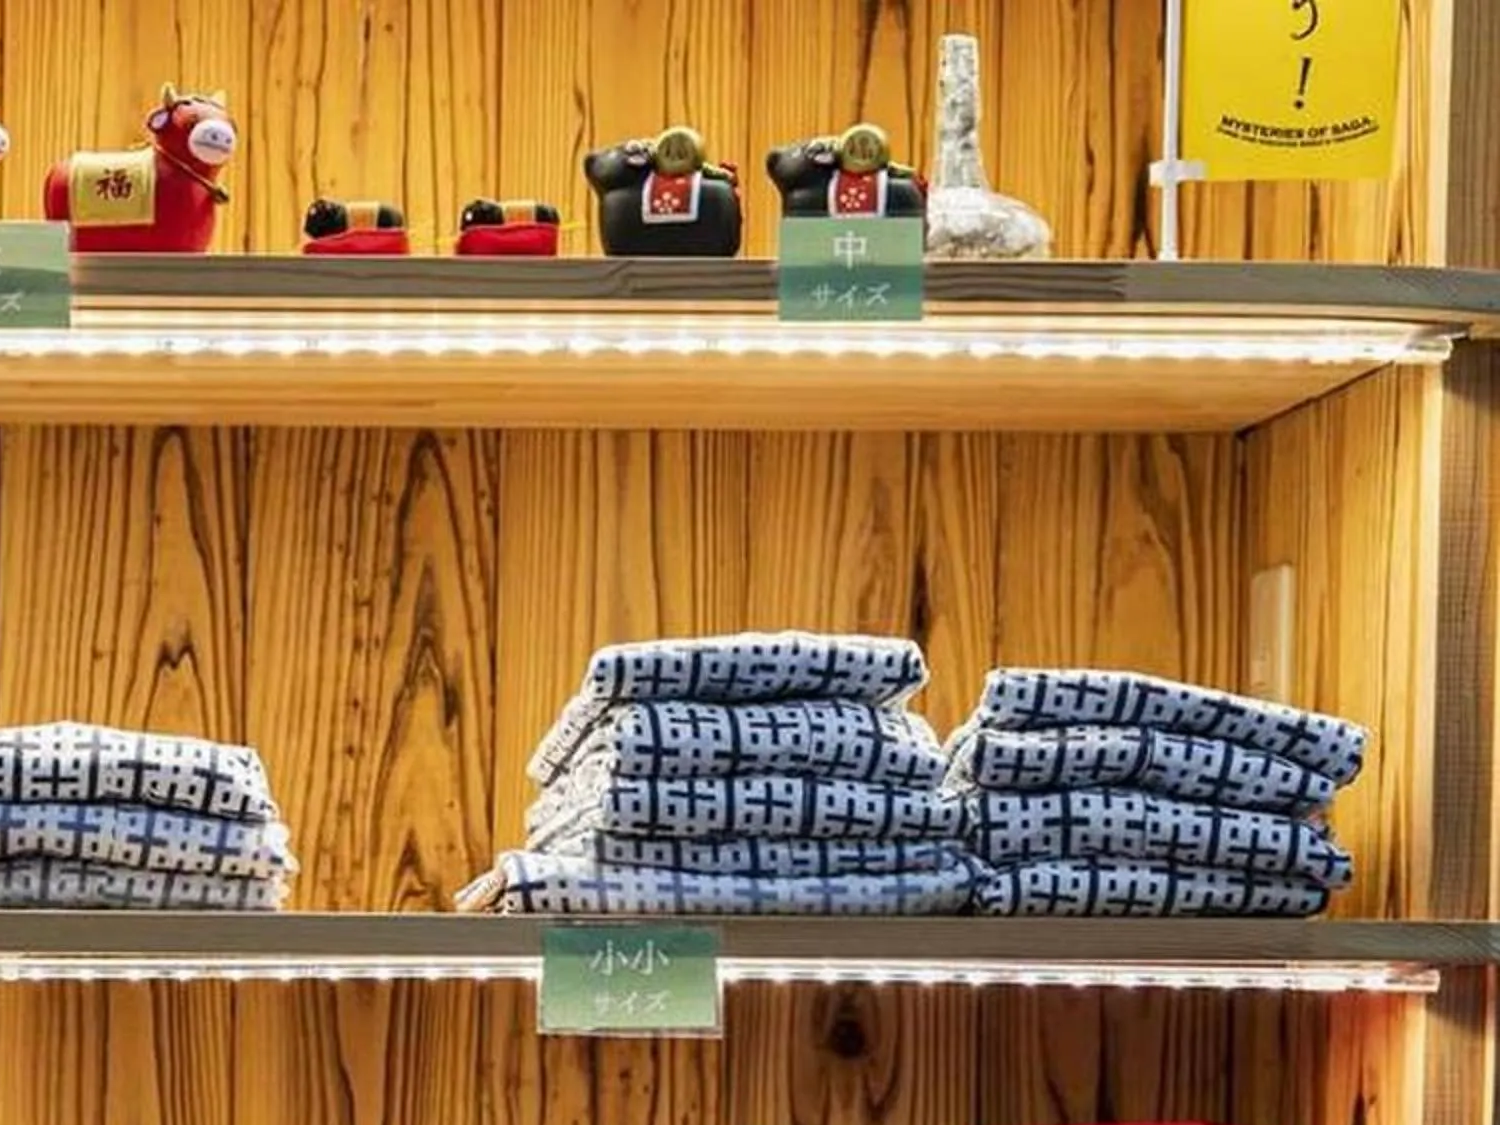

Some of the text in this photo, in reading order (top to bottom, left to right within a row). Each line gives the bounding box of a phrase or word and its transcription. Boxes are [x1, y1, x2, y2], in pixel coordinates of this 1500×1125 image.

[1221, 114, 1304, 138] MYSTERIES
[1307, 126, 1329, 138] OF
[1332, 116, 1371, 134] SAGA
[96, 168, 132, 200] 福
[832, 230, 867, 270] 中
[810, 282, 891, 309] サイズ
[590, 939, 670, 976] 小小
[595, 989, 672, 1018] サイズ
